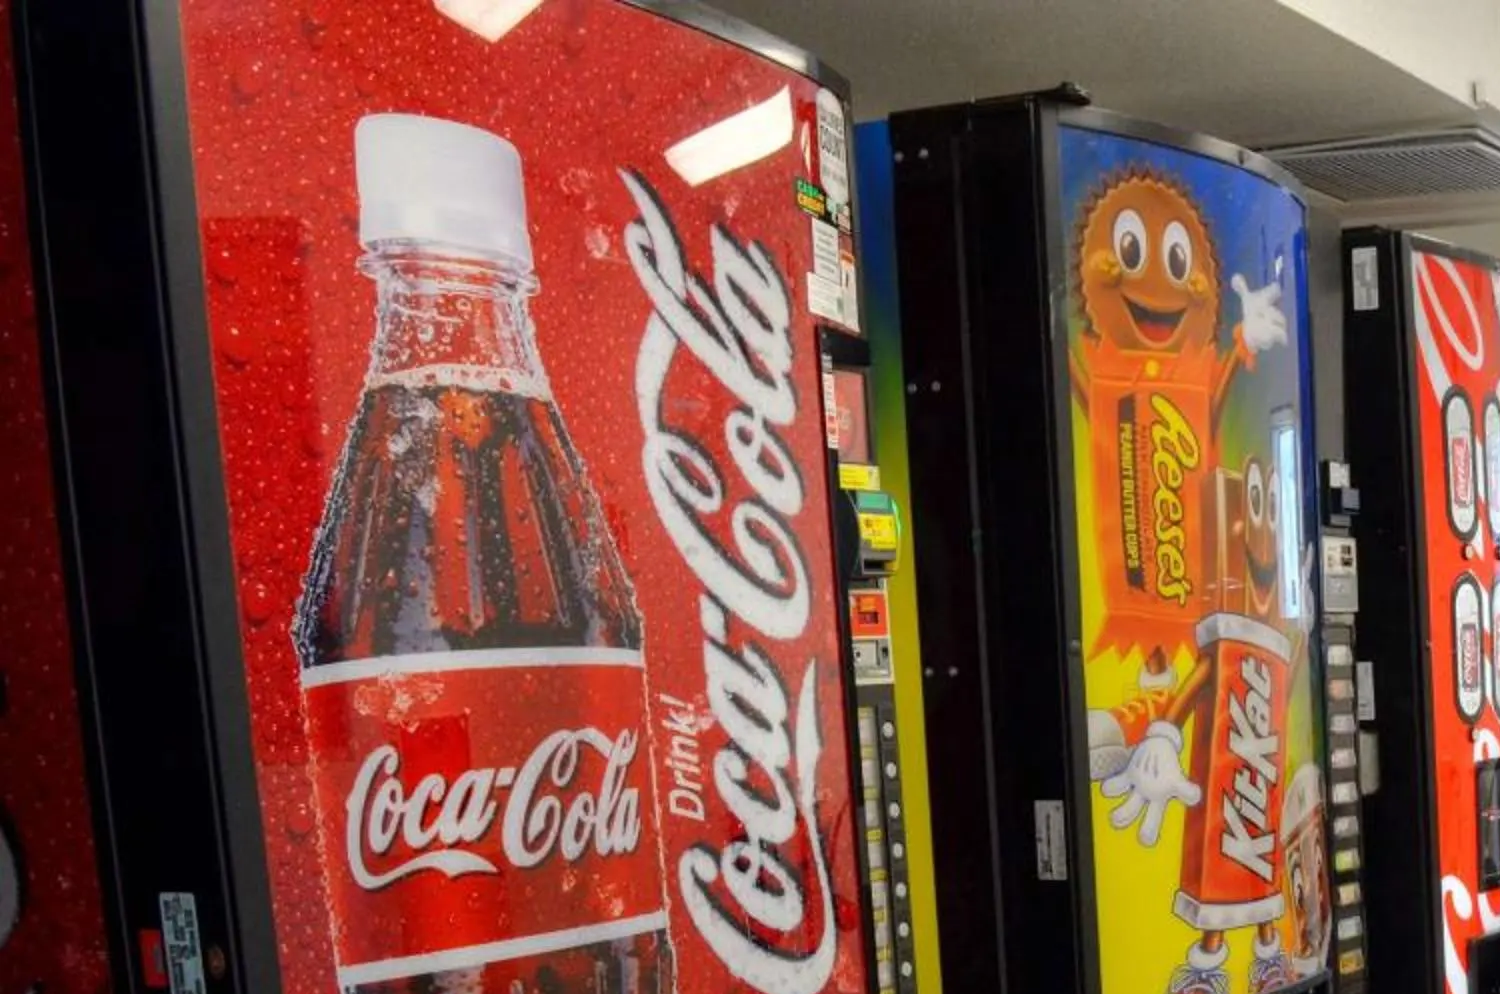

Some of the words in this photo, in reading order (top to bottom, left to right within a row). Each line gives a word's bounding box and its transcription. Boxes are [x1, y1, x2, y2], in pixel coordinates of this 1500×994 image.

[1119, 423, 1134, 478] PEANUT
[1122, 478, 1137, 532] BUTTER
[1150, 392, 1199, 607] Reese's
[1126, 533, 1140, 569] CUPS
[659, 693, 705, 821] Drink!
[346, 727, 642, 890] Coca-Cola
